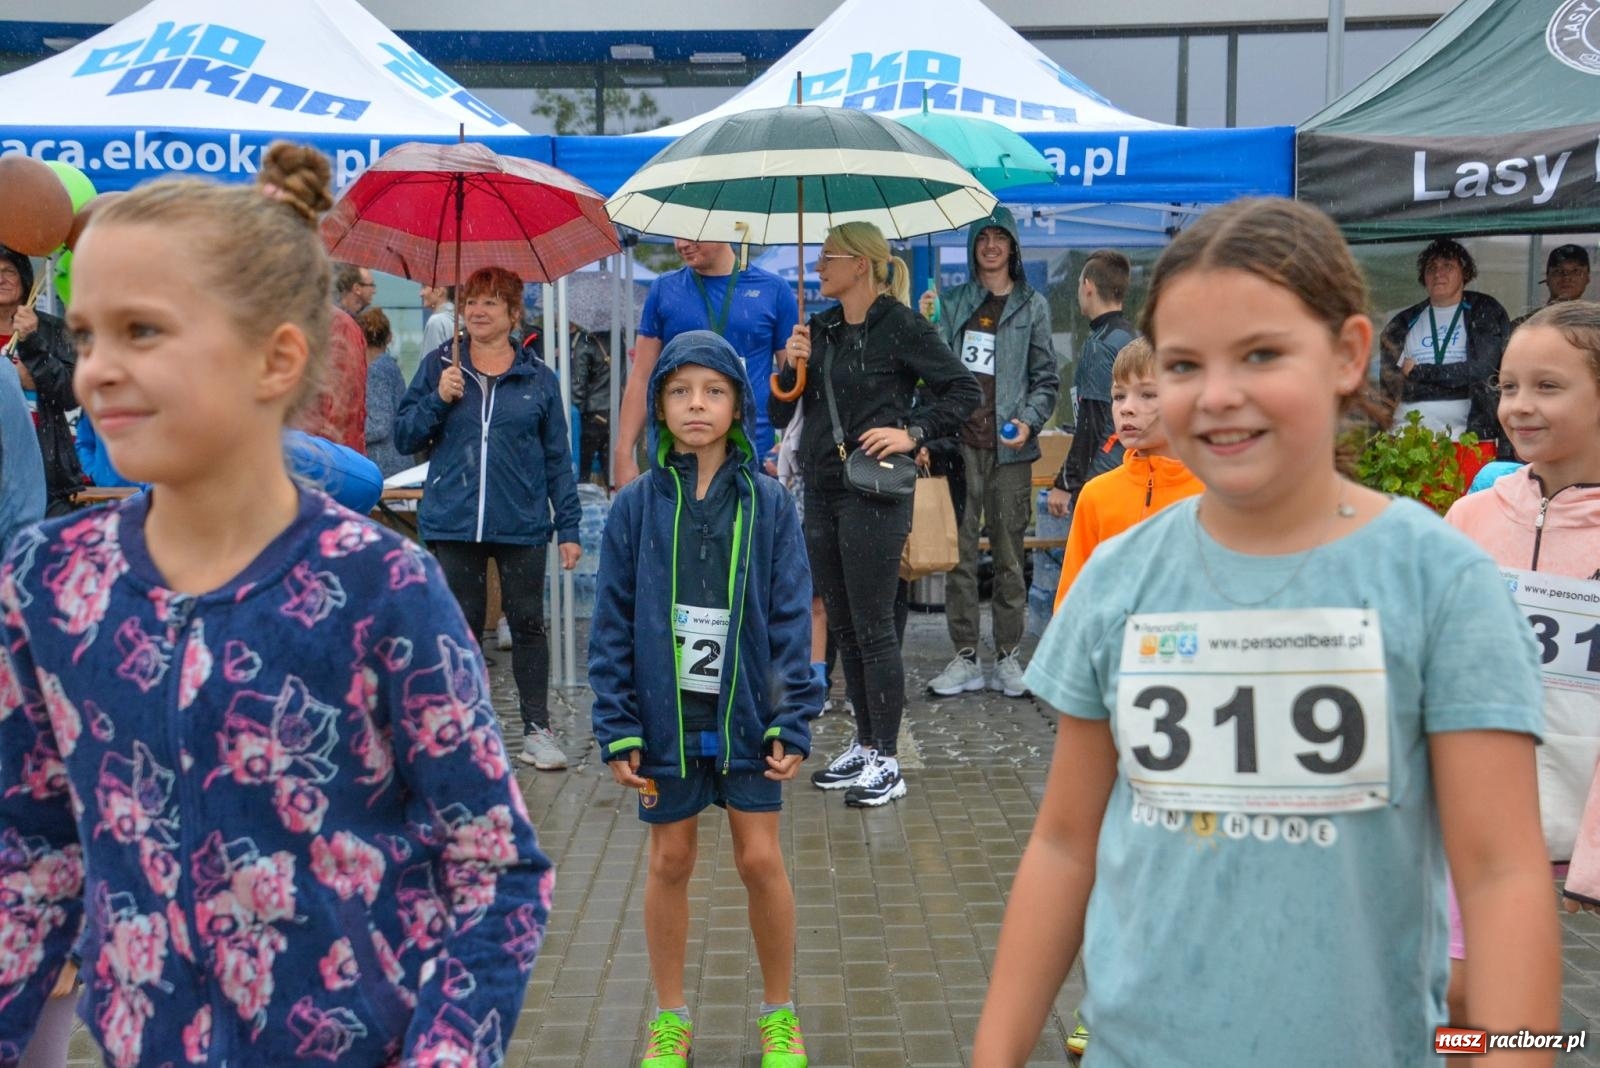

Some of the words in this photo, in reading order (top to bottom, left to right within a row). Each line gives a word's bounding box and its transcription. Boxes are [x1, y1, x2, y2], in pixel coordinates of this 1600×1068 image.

[1562, 2, 1593, 41] LASY
[1413, 150, 1572, 204] Lasy
[964, 345, 995, 366] 37
[1207, 633, 1365, 652] www.personalbest.pl
[1130, 684, 1367, 776] 319
